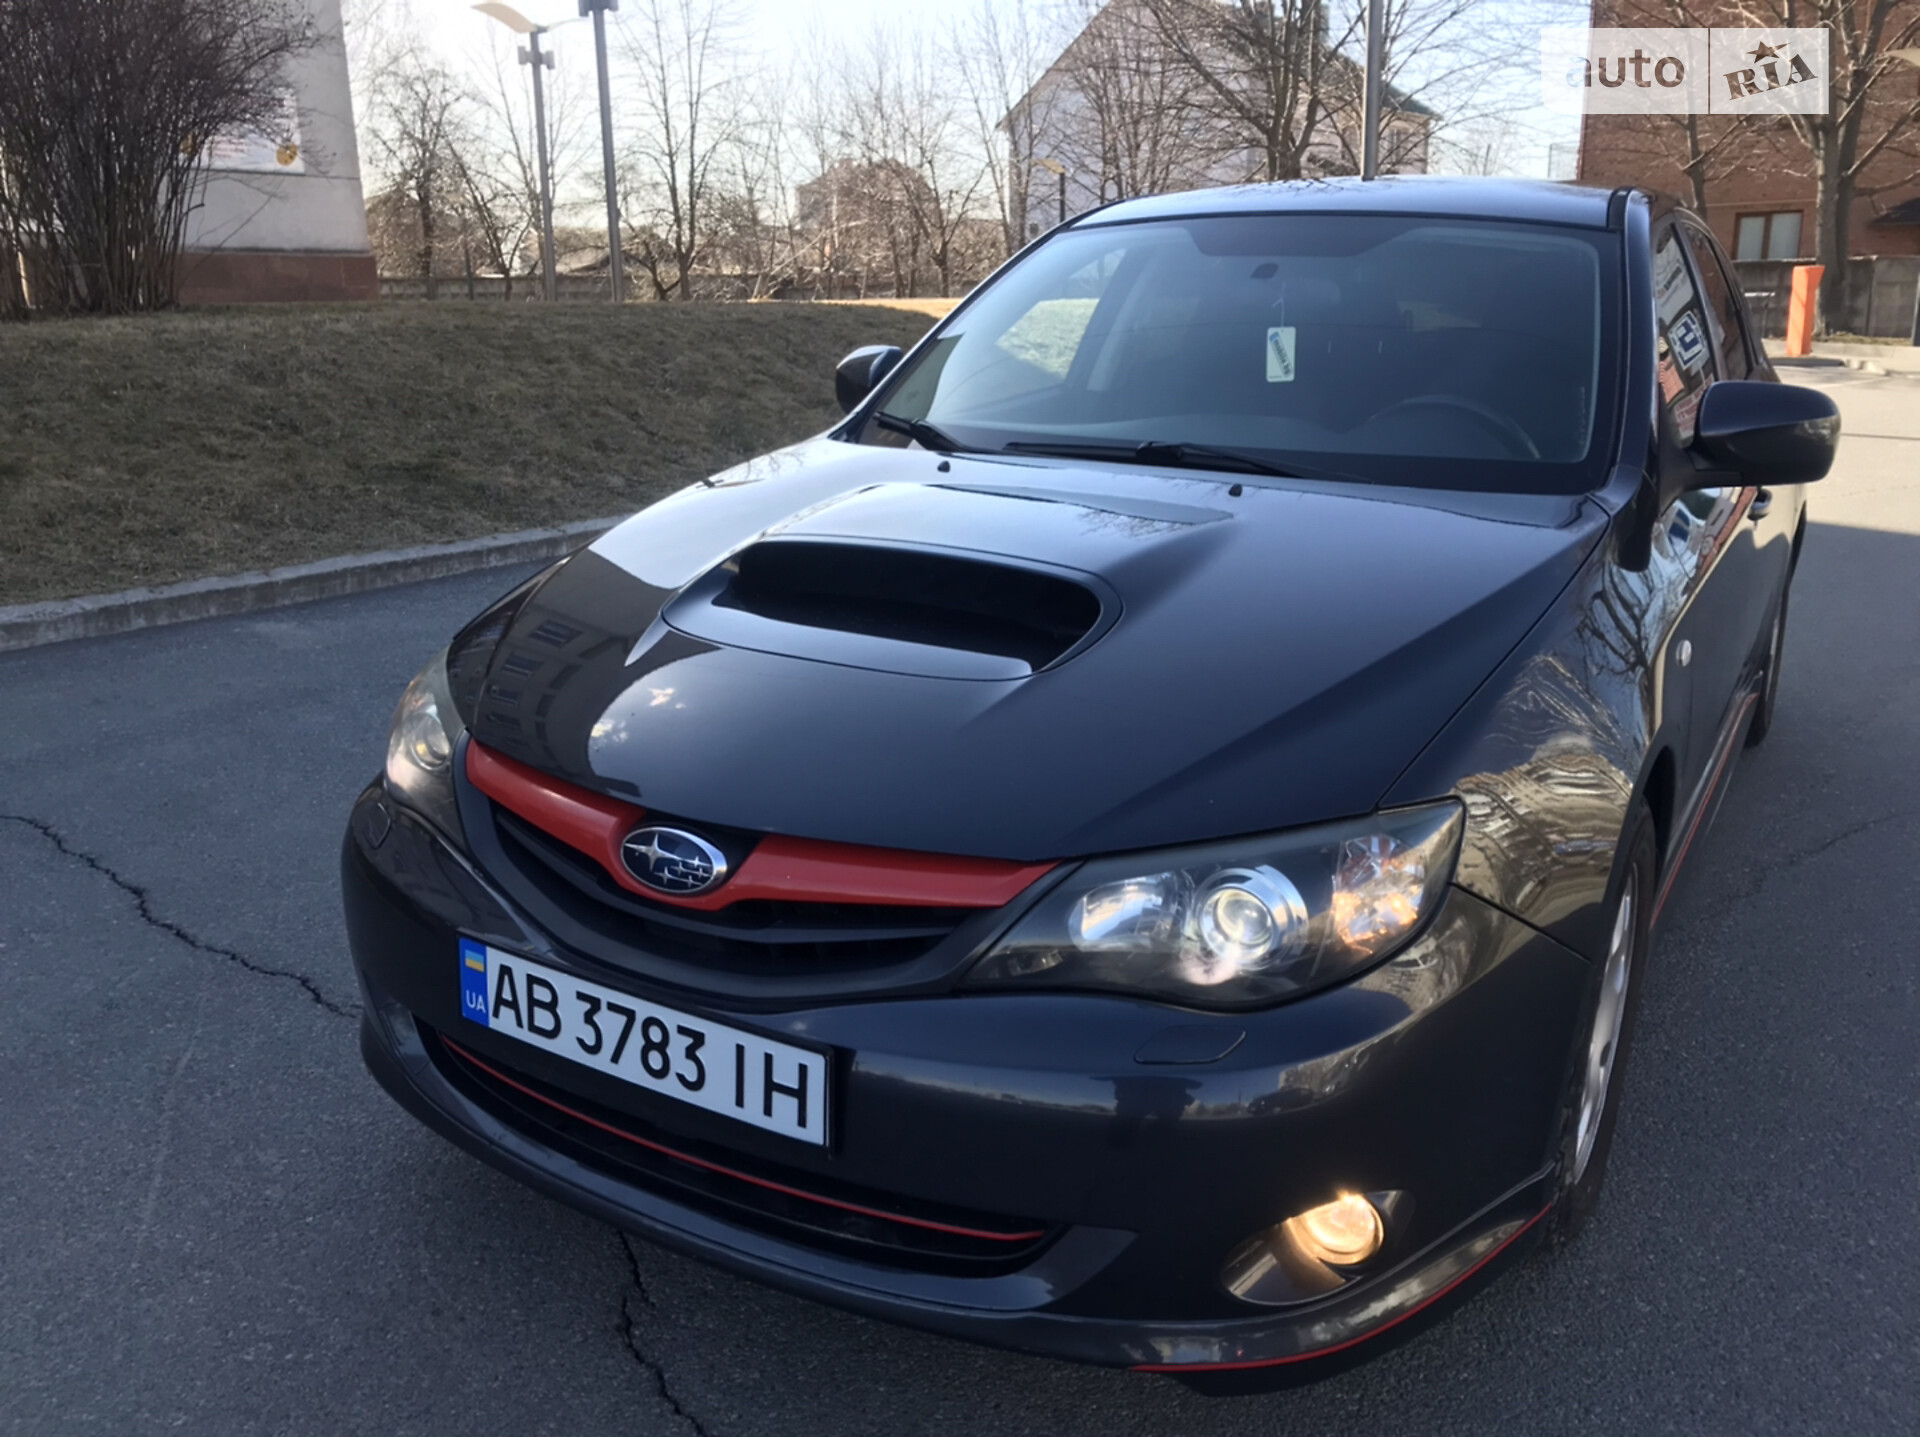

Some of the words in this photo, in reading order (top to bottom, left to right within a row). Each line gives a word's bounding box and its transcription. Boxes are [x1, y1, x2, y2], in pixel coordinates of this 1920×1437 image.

[465, 990, 487, 1014] UA
[492, 963, 562, 1040] AB
[575, 990, 707, 1092] 3783
[734, 1043, 808, 1128] IH
